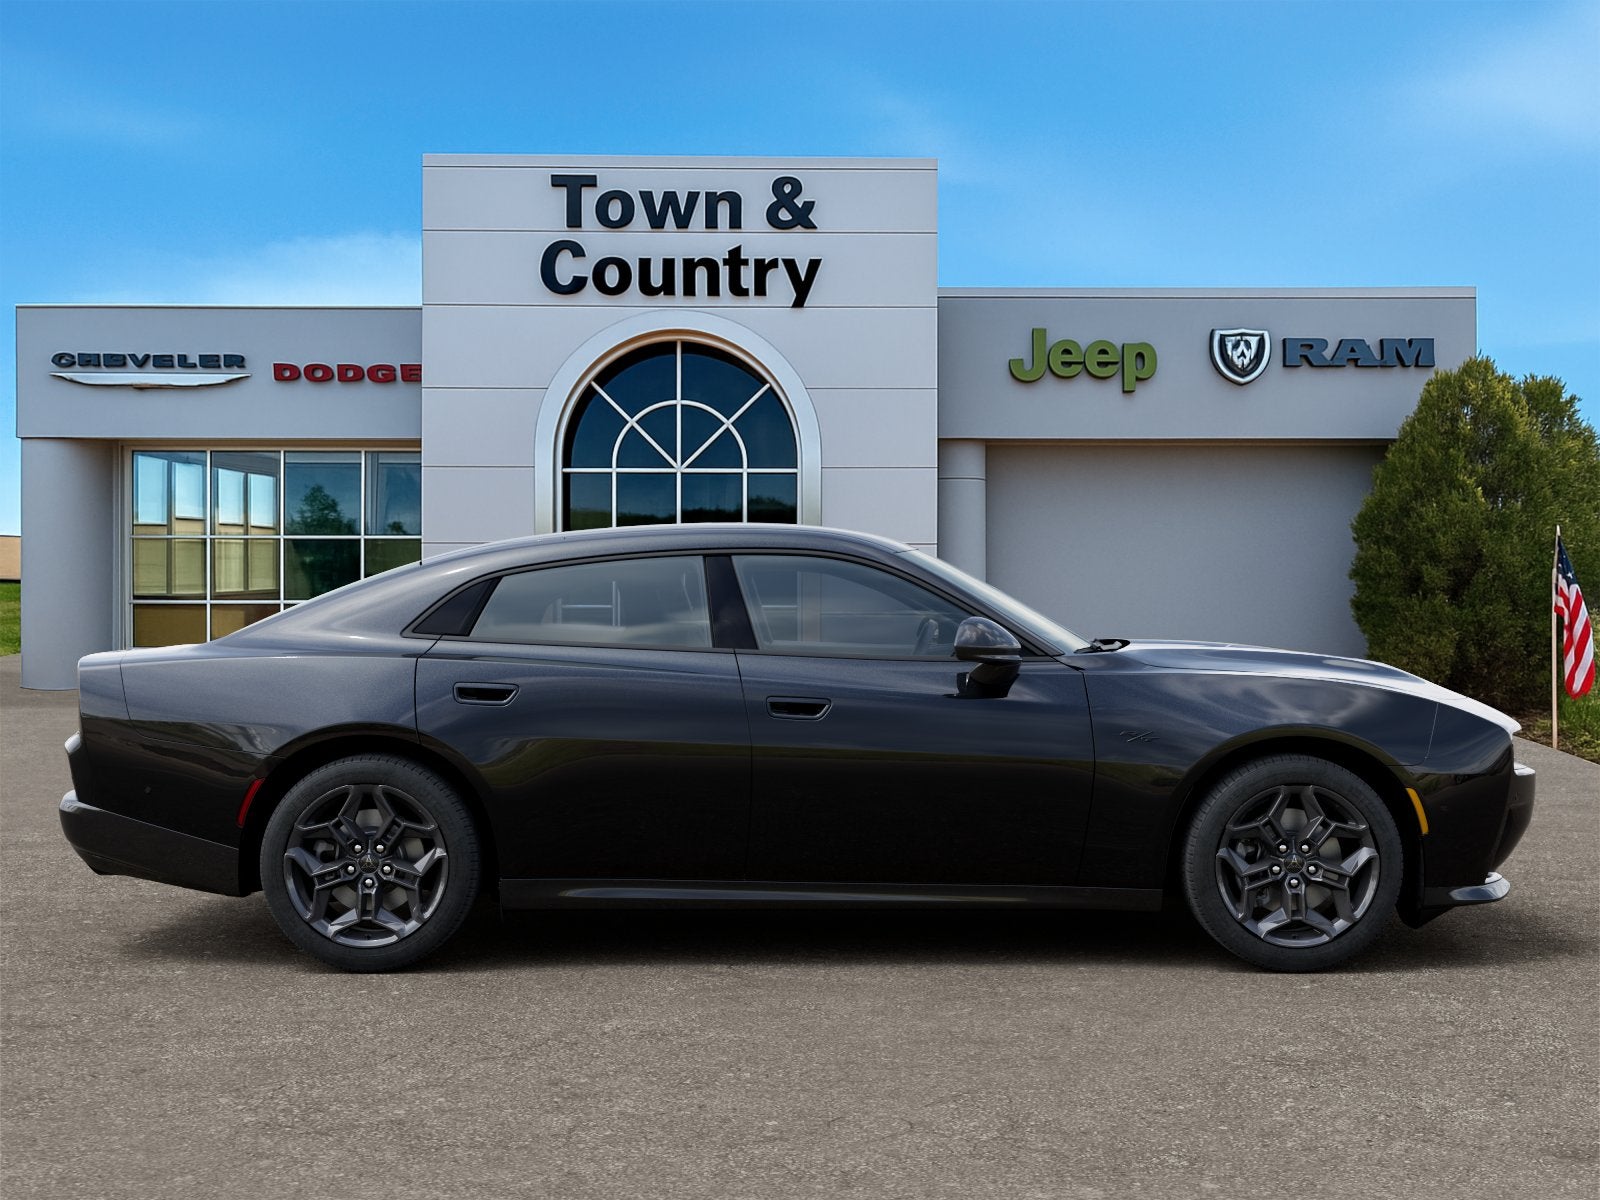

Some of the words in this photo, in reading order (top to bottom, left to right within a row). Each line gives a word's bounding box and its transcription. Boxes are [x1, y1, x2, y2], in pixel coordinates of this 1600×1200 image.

[550, 174, 743, 230] Town
[765, 176, 818, 230] &
[540, 239, 822, 308] Country
[272, 363, 422, 383] DODGE
[1008, 327, 1158, 393] Jeep
[1282, 337, 1435, 368] RAM
